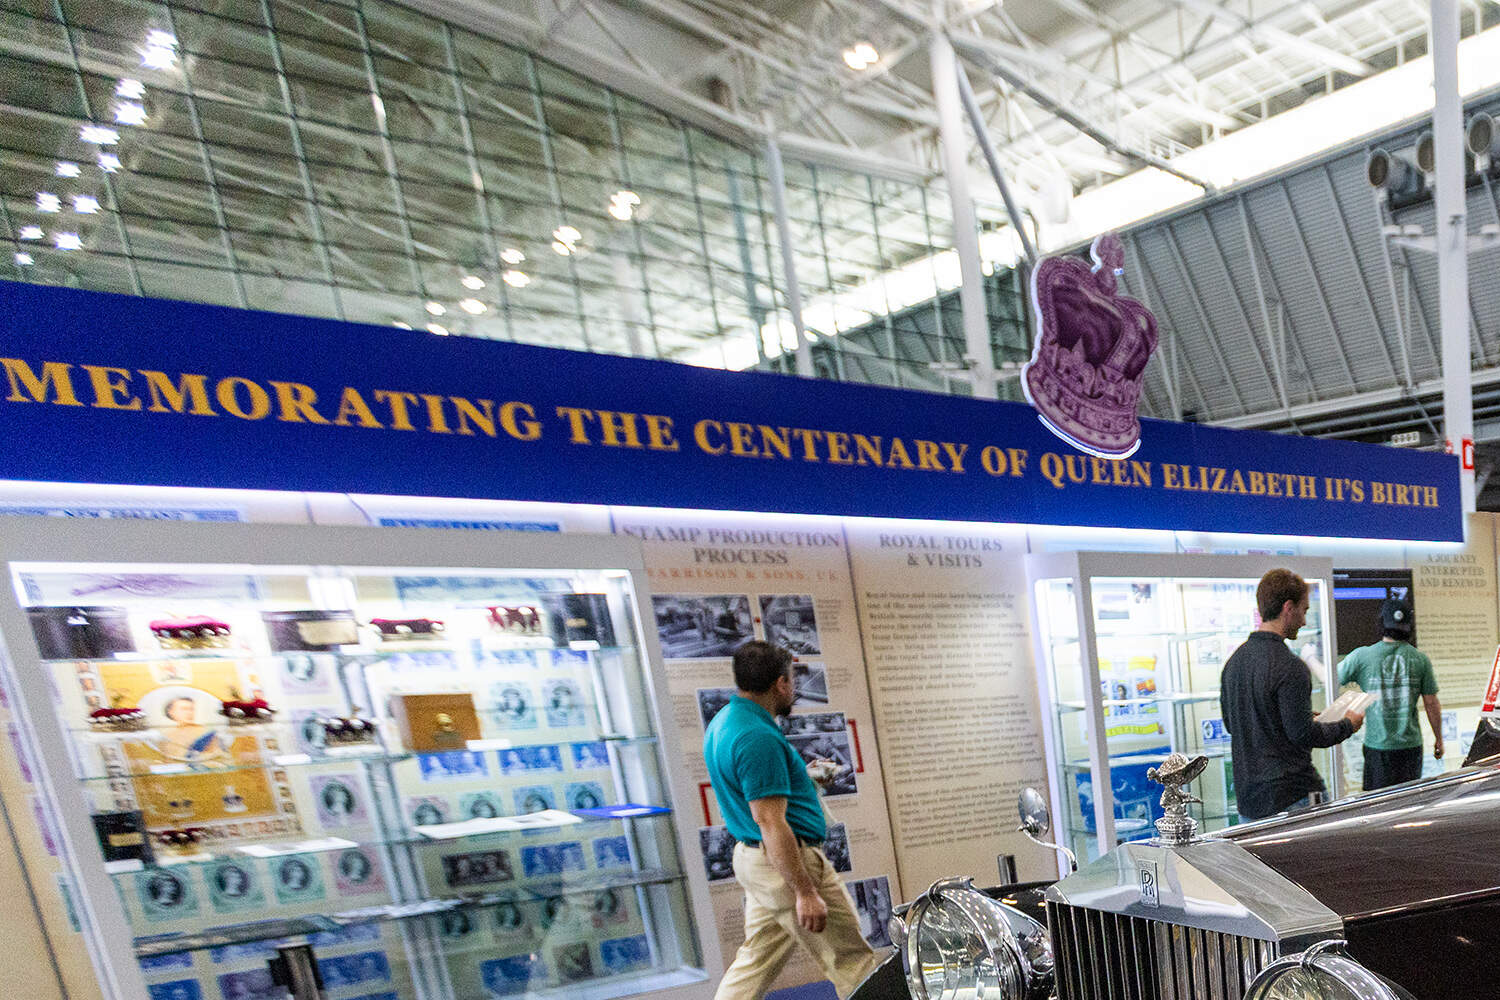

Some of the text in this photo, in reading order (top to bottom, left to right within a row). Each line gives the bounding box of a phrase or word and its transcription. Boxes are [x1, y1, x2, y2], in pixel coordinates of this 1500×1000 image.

[0, 357, 541, 440] MEMORATING
[556, 406, 680, 450] THE
[693, 418, 967, 475] CENTENARY
[981, 446, 1028, 476] OF
[1040, 452, 1152, 488] QUEEN
[1162, 463, 1318, 500] ELIZABETH
[1371, 482, 1440, 508] BIRTH
[707, 527, 841, 547] PRODUCTION
[879, 532, 1003, 551] ROYAL TOURS
[693, 547, 789, 565] PROCESS
[907, 552, 983, 568] & VISITS
[1420, 577, 1440, 587] AND
